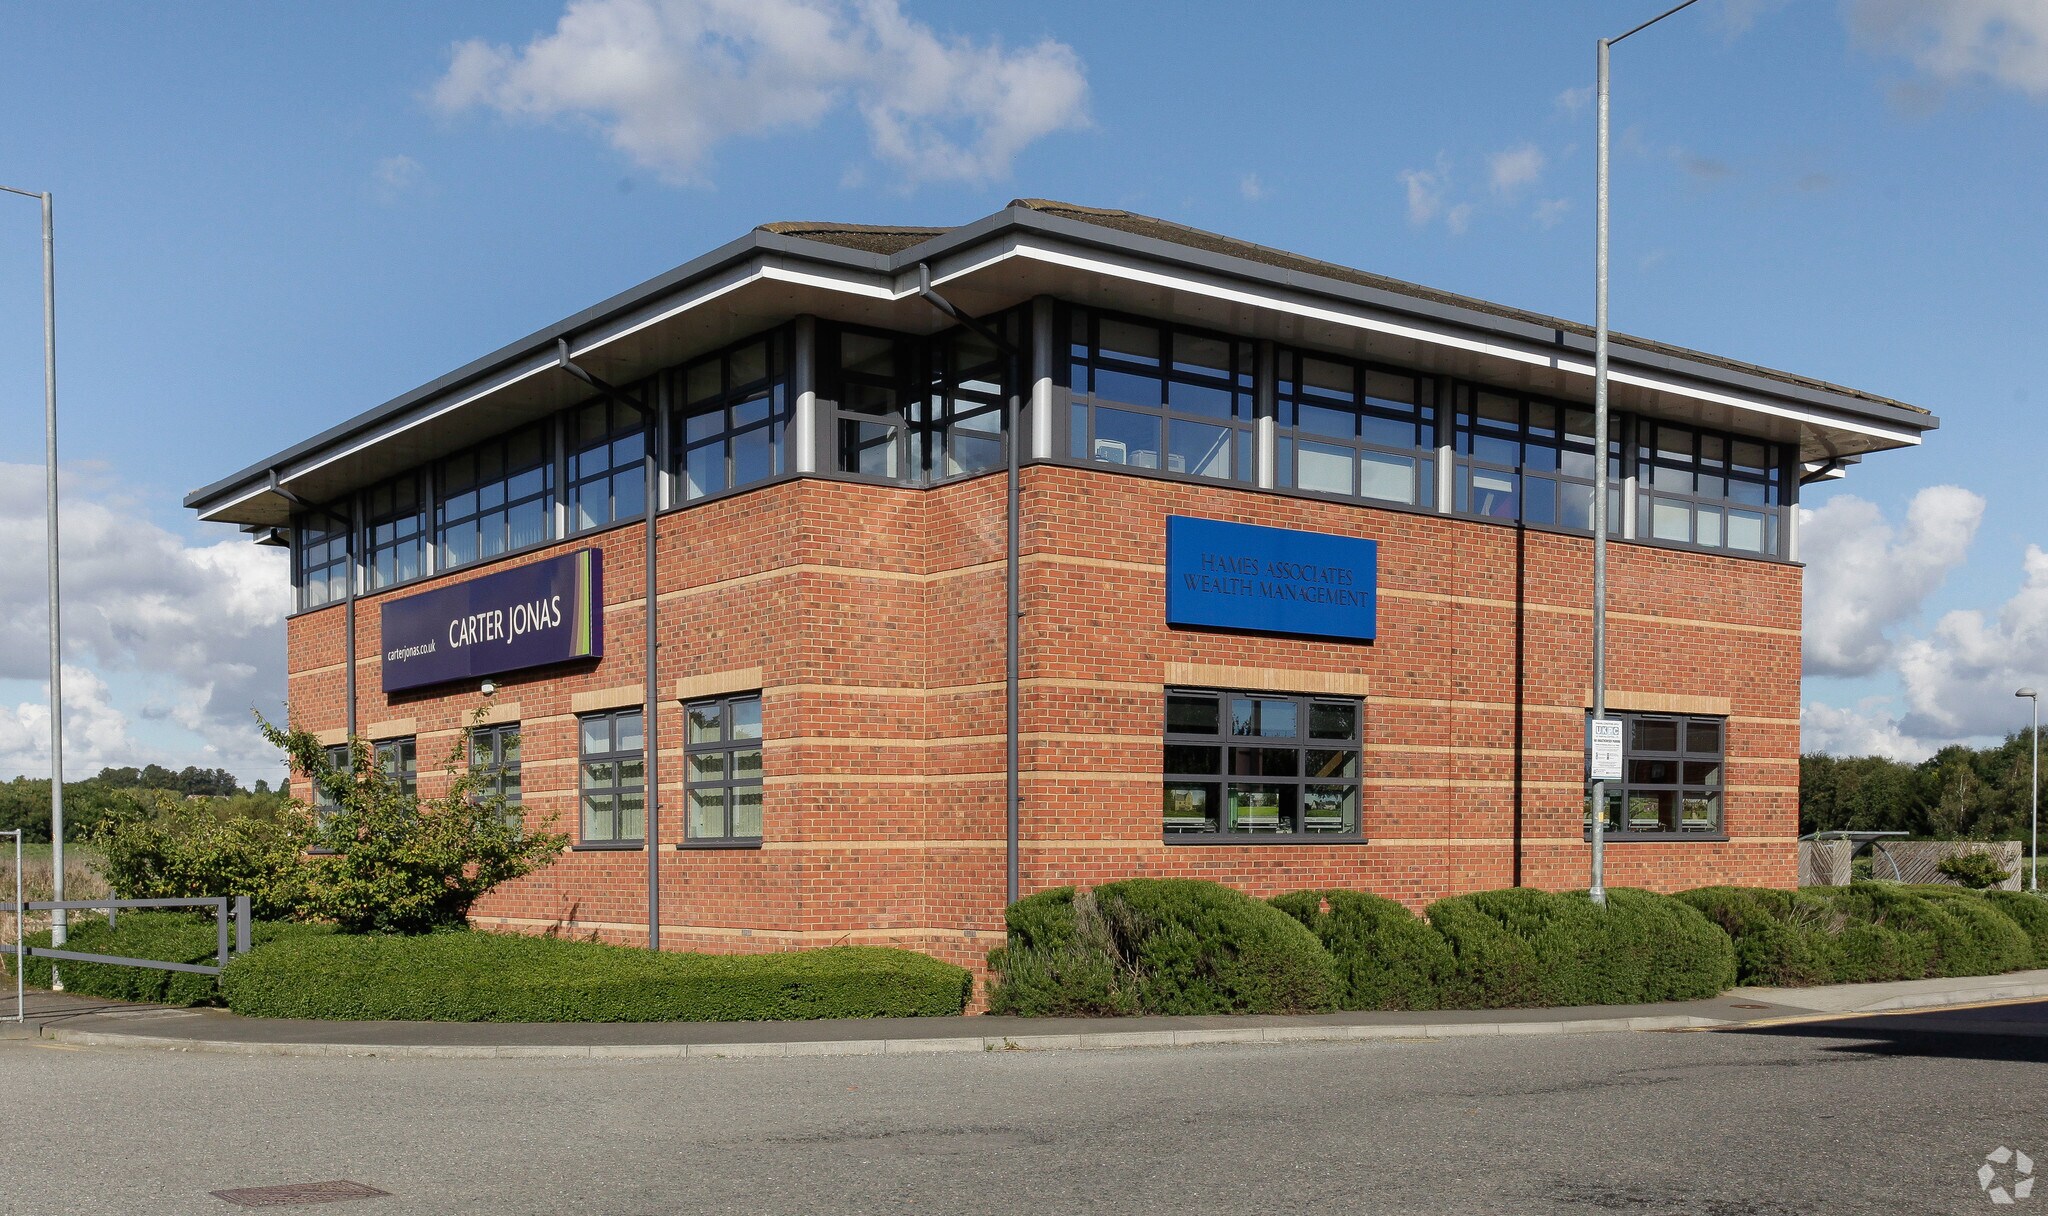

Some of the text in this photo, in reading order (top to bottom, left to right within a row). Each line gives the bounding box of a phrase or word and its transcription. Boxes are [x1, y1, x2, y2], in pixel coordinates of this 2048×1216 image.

[1201, 552, 1353, 585] HAMES ASSOCIATES
[1184, 573, 1369, 608] WEALTH MANAGEMENT
[449, 595, 561, 648] CARTER JONAS
[387, 639, 436, 662] carterjonas.co.uk
[1596, 726, 1619, 735] UKPC
